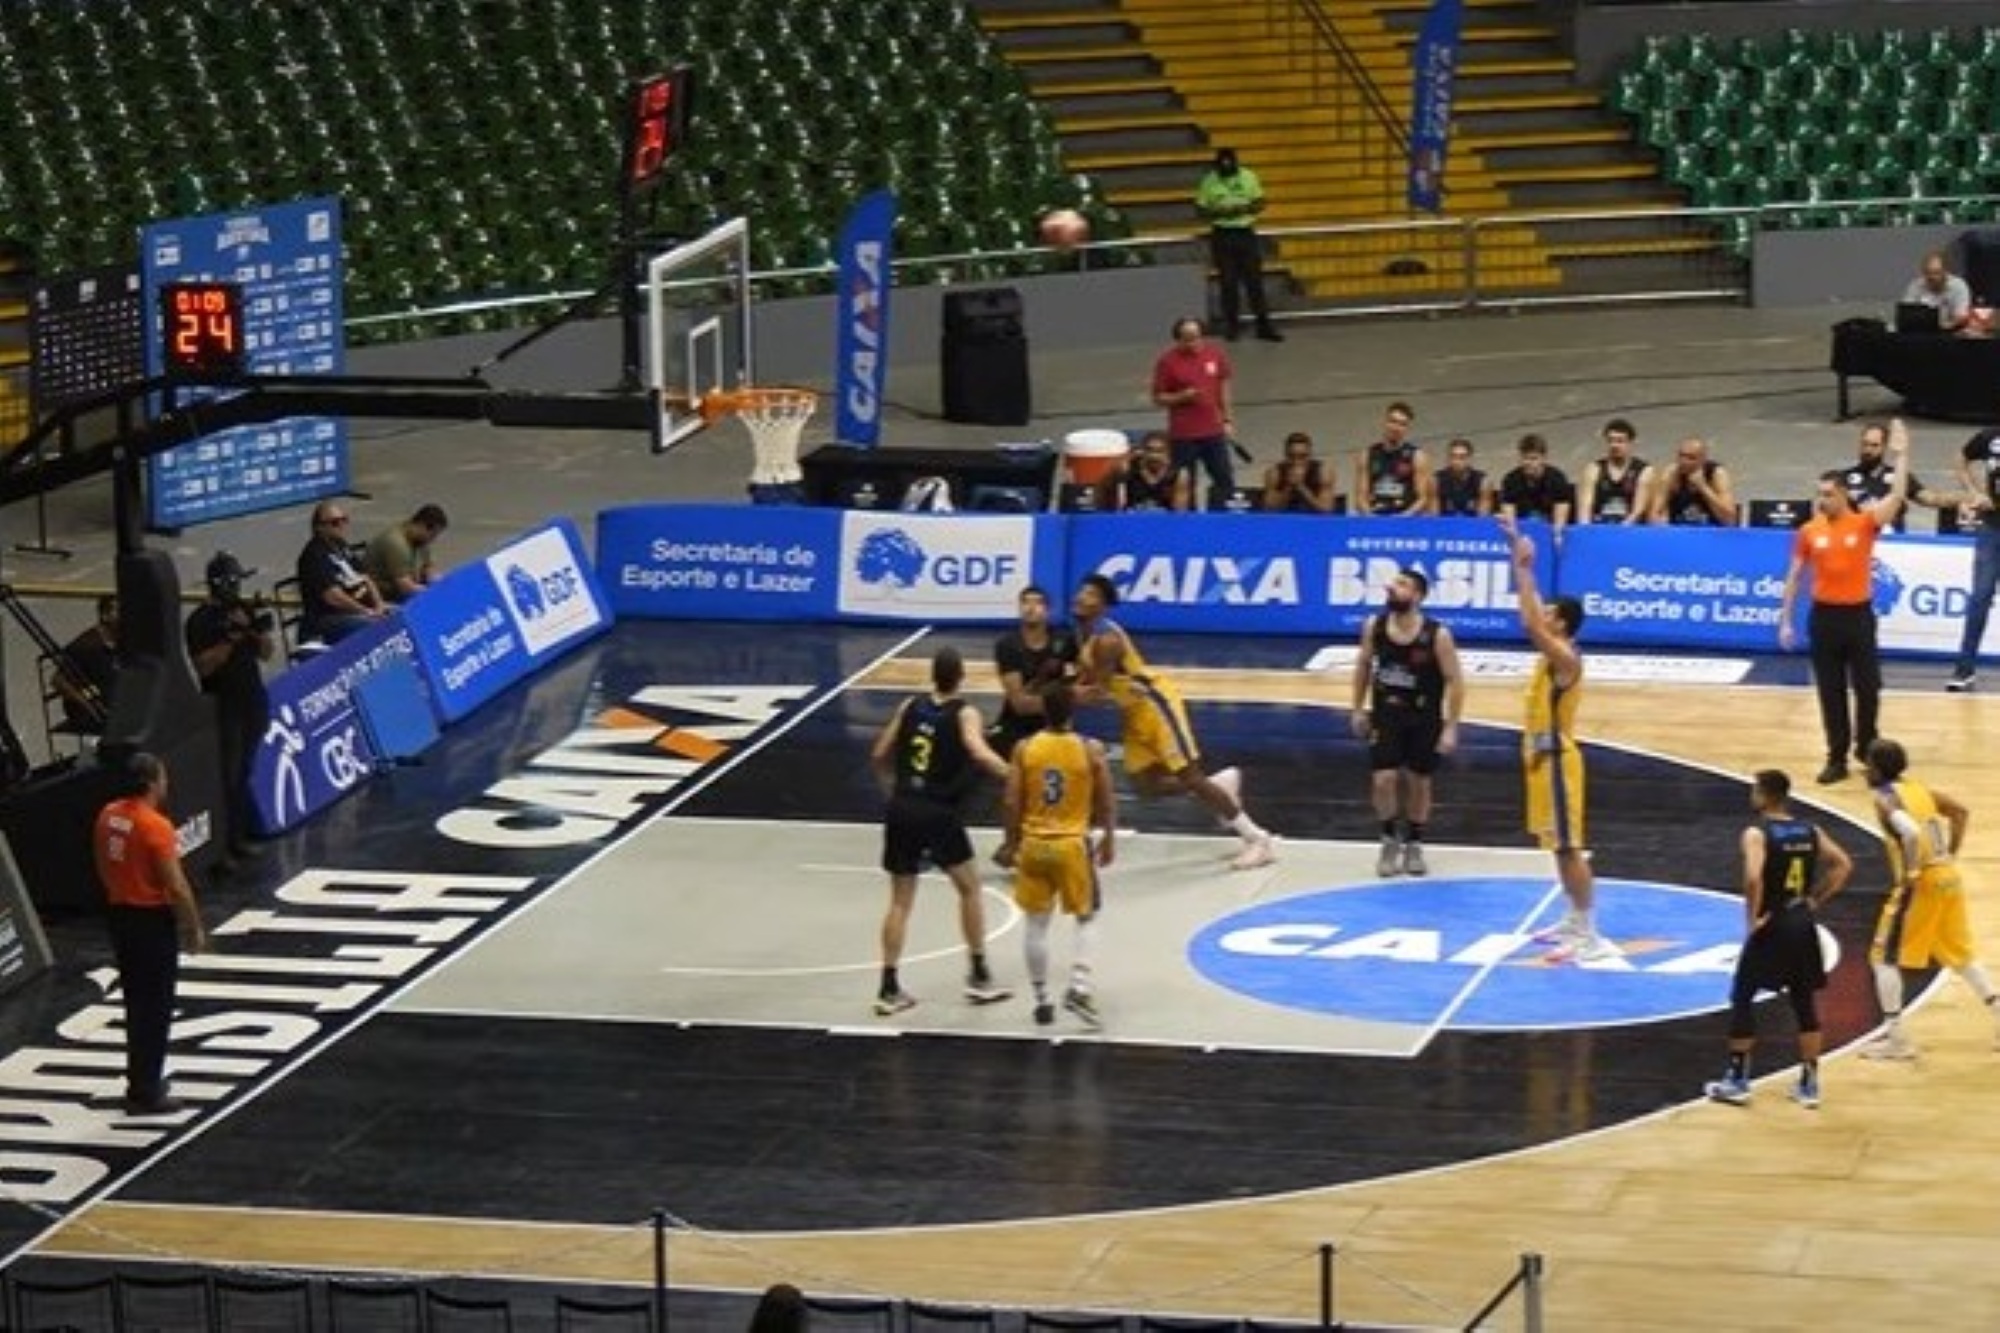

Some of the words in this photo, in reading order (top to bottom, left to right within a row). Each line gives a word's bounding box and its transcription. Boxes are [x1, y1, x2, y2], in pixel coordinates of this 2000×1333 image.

[177, 314, 233, 354] 24
[850, 240, 882, 424] CAIXA
[651, 539, 777, 565] Secretaria
[783, 545, 816, 567] de
[1346, 537, 1429, 551] GOVERNO
[621, 565, 718, 589] Esporte
[723, 572, 739, 589] e
[745, 570, 815, 593] Lazer
[931, 555, 1018, 586] GDF
[1099, 553, 1300, 606] CAIXA
[1615, 566, 1747, 596] Secretaria
[1753, 573, 1786, 597] de
[1583, 593, 1683, 621] Esporte
[1688, 602, 1708, 621] e
[1712, 600, 1784, 624] Lazer
[1909, 585, 1970, 618] GD
[435, 685, 820, 848] CAIXA
[911, 735, 933, 773] 3
[1041, 767, 1064, 806] 3
[1784, 856, 1806, 899] 4
